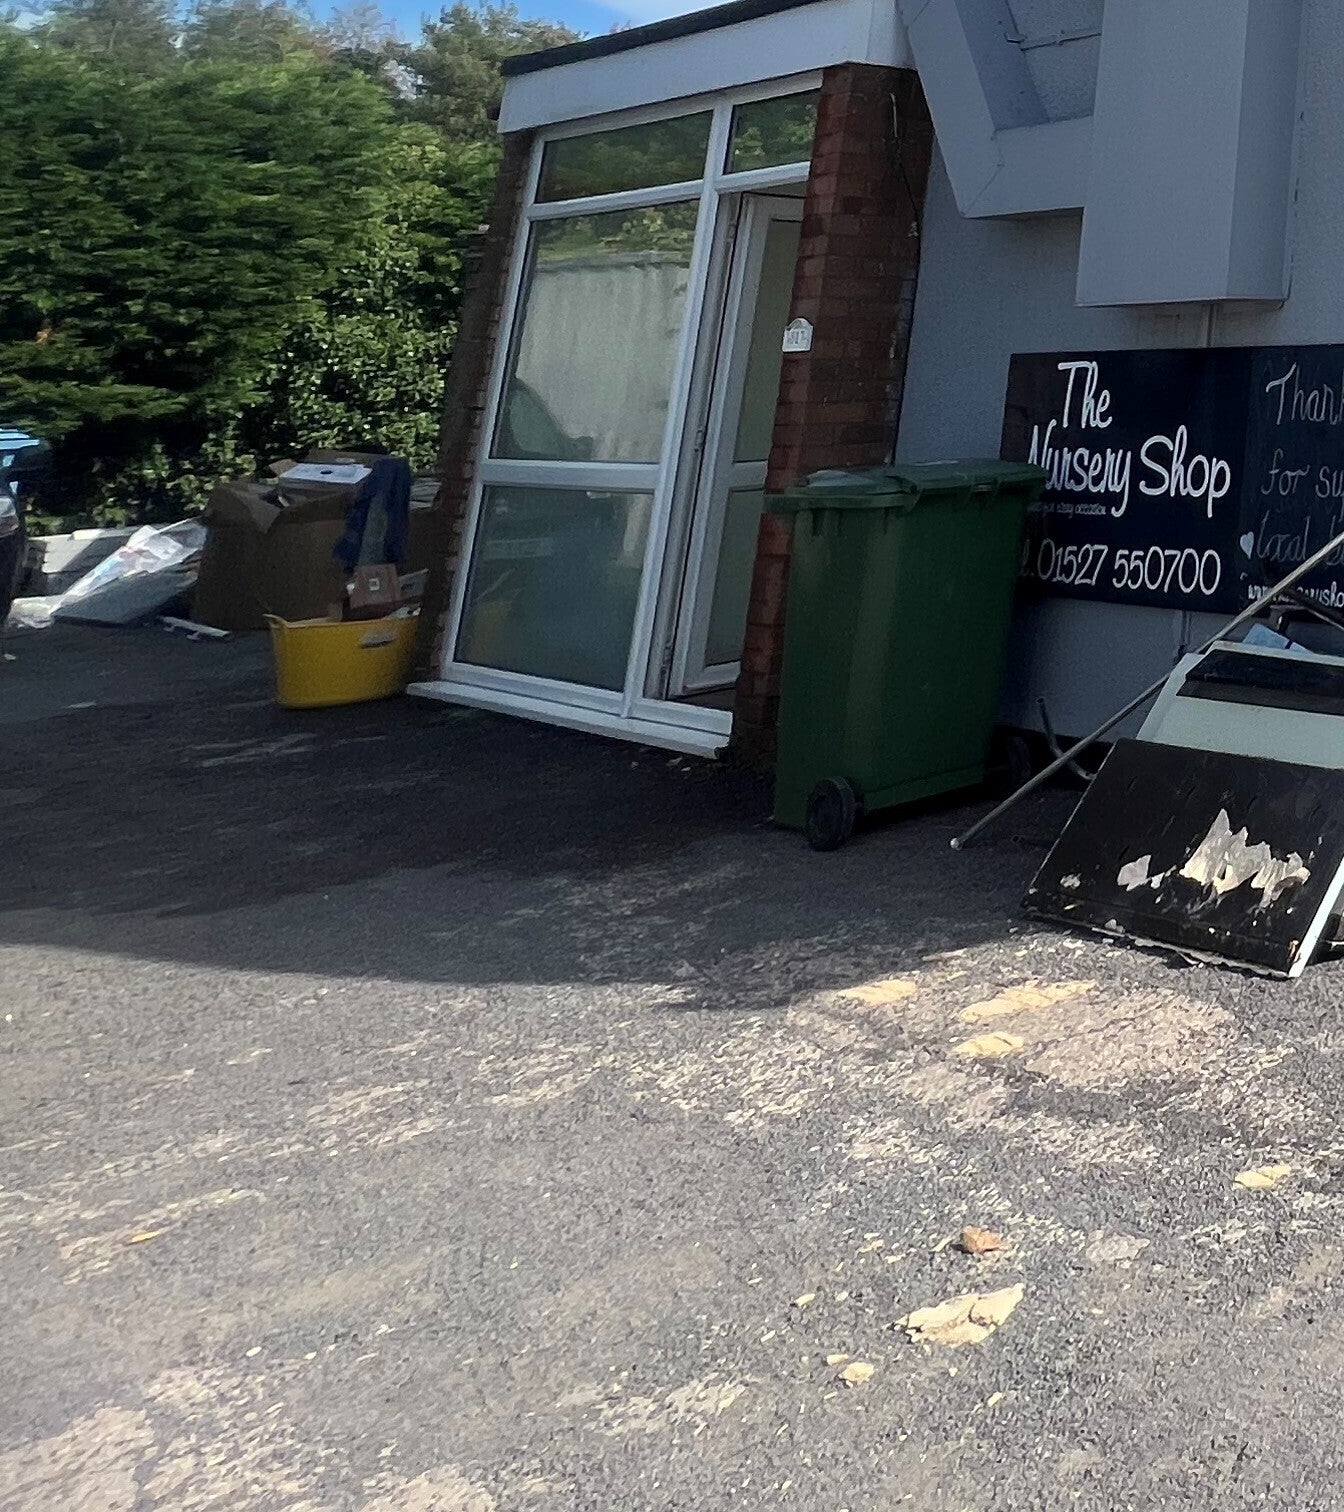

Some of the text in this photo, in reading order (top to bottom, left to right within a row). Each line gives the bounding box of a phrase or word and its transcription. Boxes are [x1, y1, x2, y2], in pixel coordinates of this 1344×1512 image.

[1057, 360, 1113, 430] The
[1028, 418, 1231, 519] Nursery Shop
[1260, 448, 1310, 497] for
[1257, 509, 1311, 563] local
[1037, 537, 1109, 586] 01527
[1112, 545, 1222, 596] 550700
